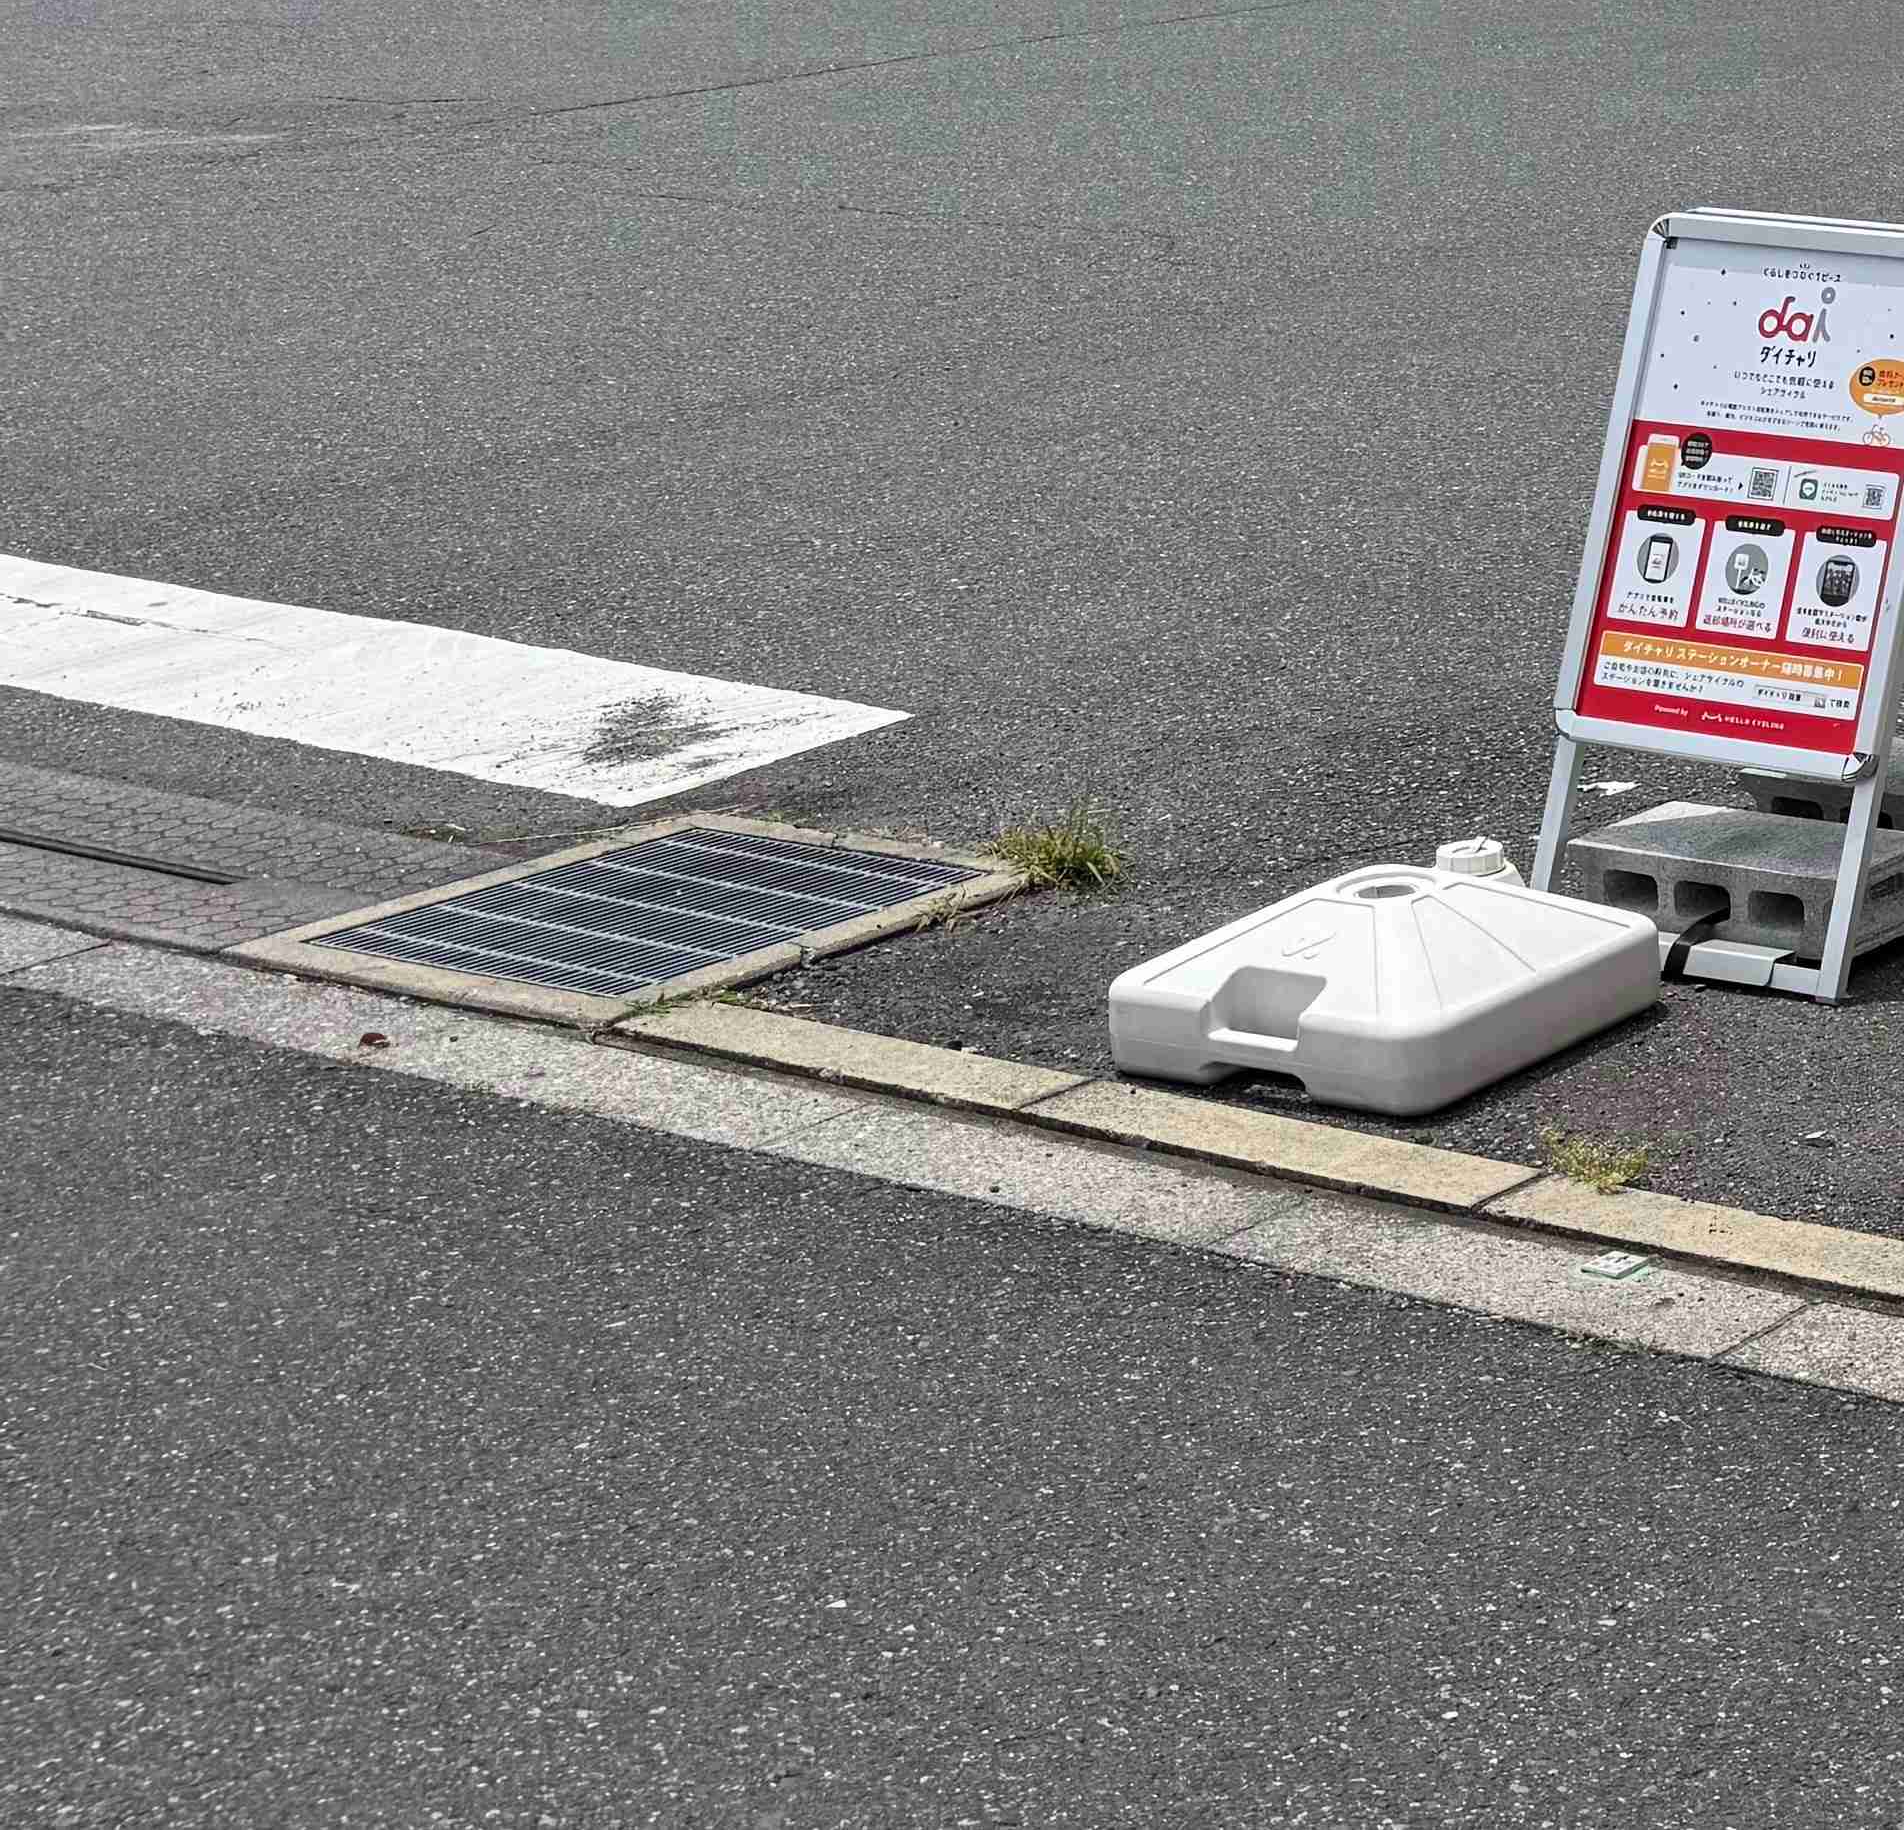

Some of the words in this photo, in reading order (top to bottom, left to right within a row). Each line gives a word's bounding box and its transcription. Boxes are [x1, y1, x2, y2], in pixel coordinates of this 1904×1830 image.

[1758, 286, 1836, 343] dai
[1760, 346, 1817, 368] ダイチャリ
[1760, 386, 1809, 400] シェアサイクル
[1618, 602, 1679, 620] かんたん予約
